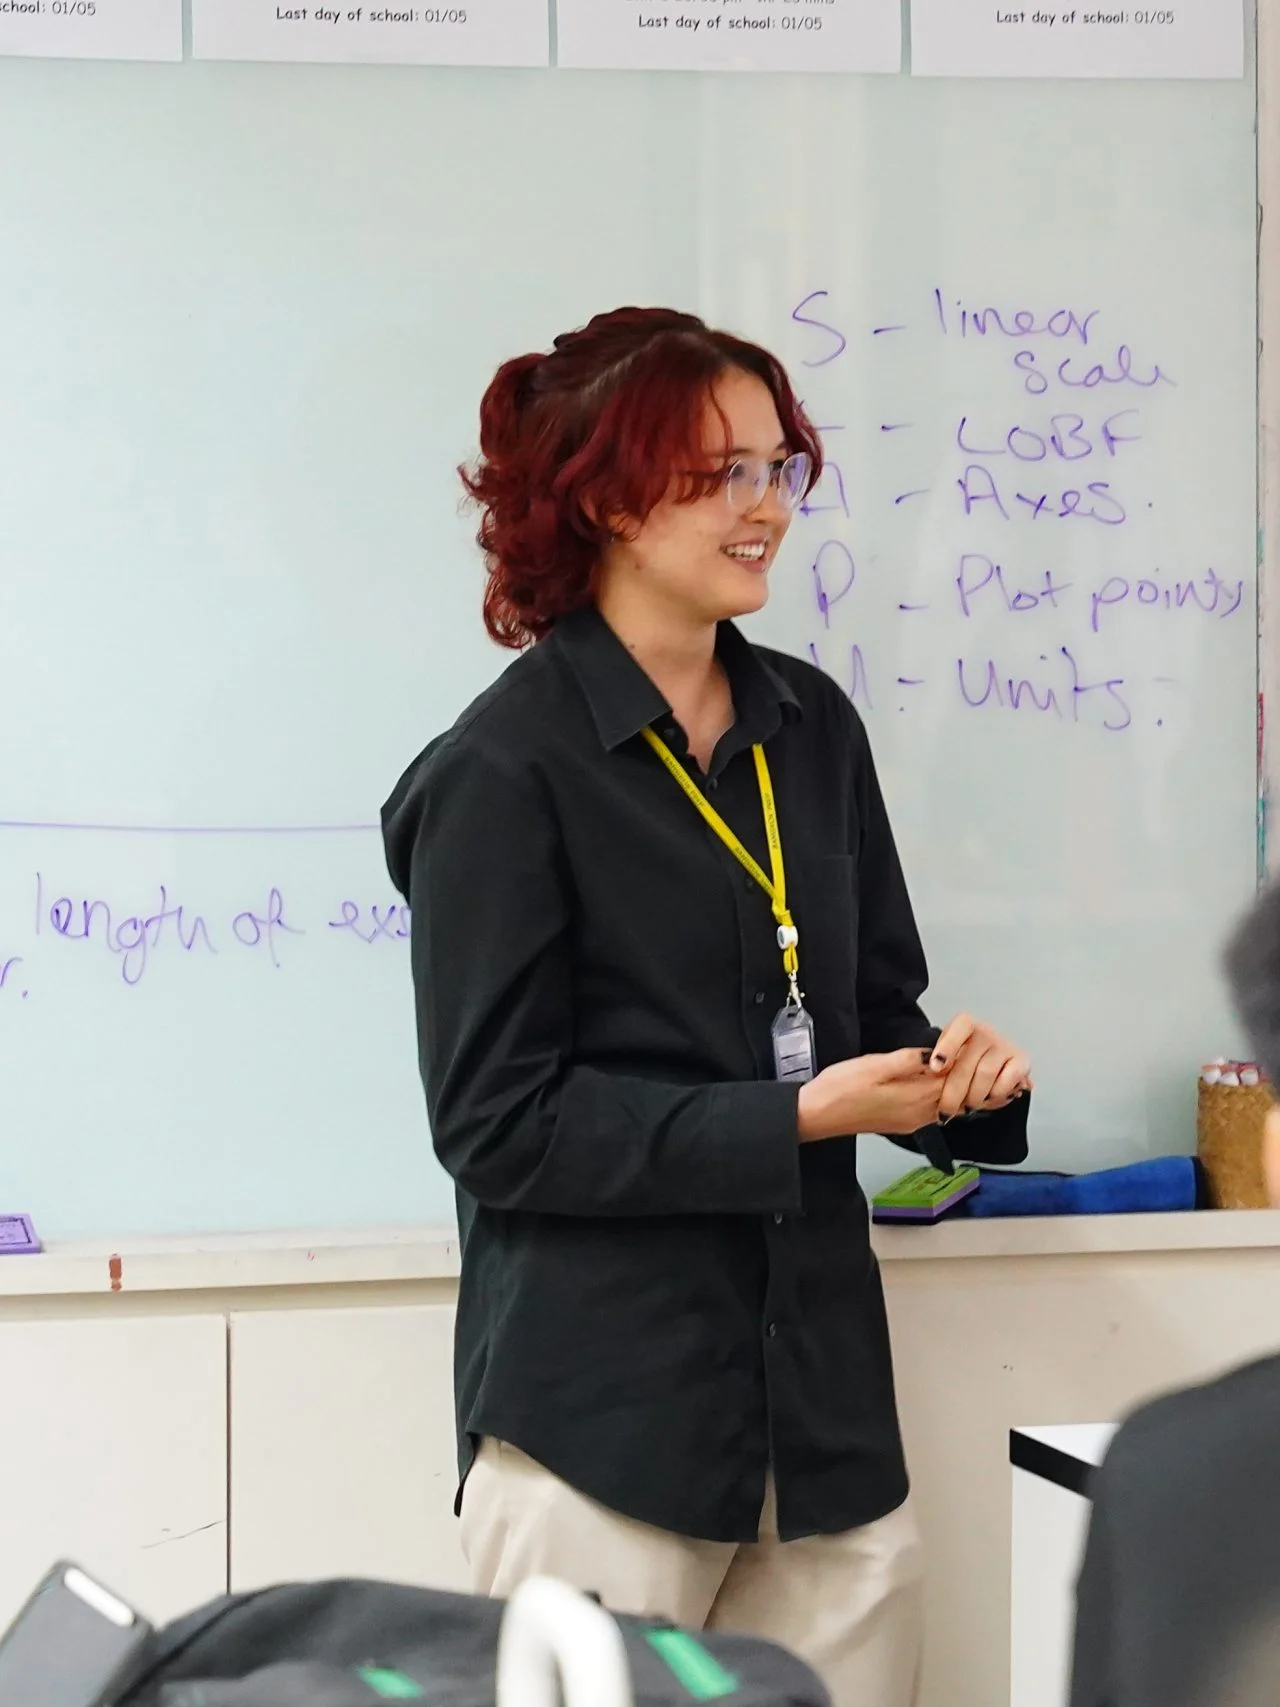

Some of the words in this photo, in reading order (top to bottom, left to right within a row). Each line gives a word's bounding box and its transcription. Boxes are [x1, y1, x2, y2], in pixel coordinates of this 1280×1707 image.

[0, 0, 46, 14] chool:
[52, 0, 96, 16] 01/05
[276, 6, 308, 20] Last
[314, 7, 341, 24] day
[347, 7, 363, 21] of
[369, 8, 418, 22] school:
[424, 9, 467, 24] 01/05
[638, 14, 669, 29] Last
[675, 15, 700, 31] day
[707, 14, 722, 30] of
[728, 15, 775, 30] school:
[781, 16, 823, 31] 01/05
[996, 10, 1025, 24] Last
[1031, 10, 1056, 27] day
[1062, 10, 1076, 24] of
[1082, 10, 1128, 25] school:
[1134, 11, 1174, 25] 01/05
[792, 290, 847, 367] S
[934, 288, 1099, 345] linear
[812, 539, 855, 630] P
[956, 553, 1073, 618] Plot
[36, 872, 219, 985] length
[232, 887, 306, 969] of
